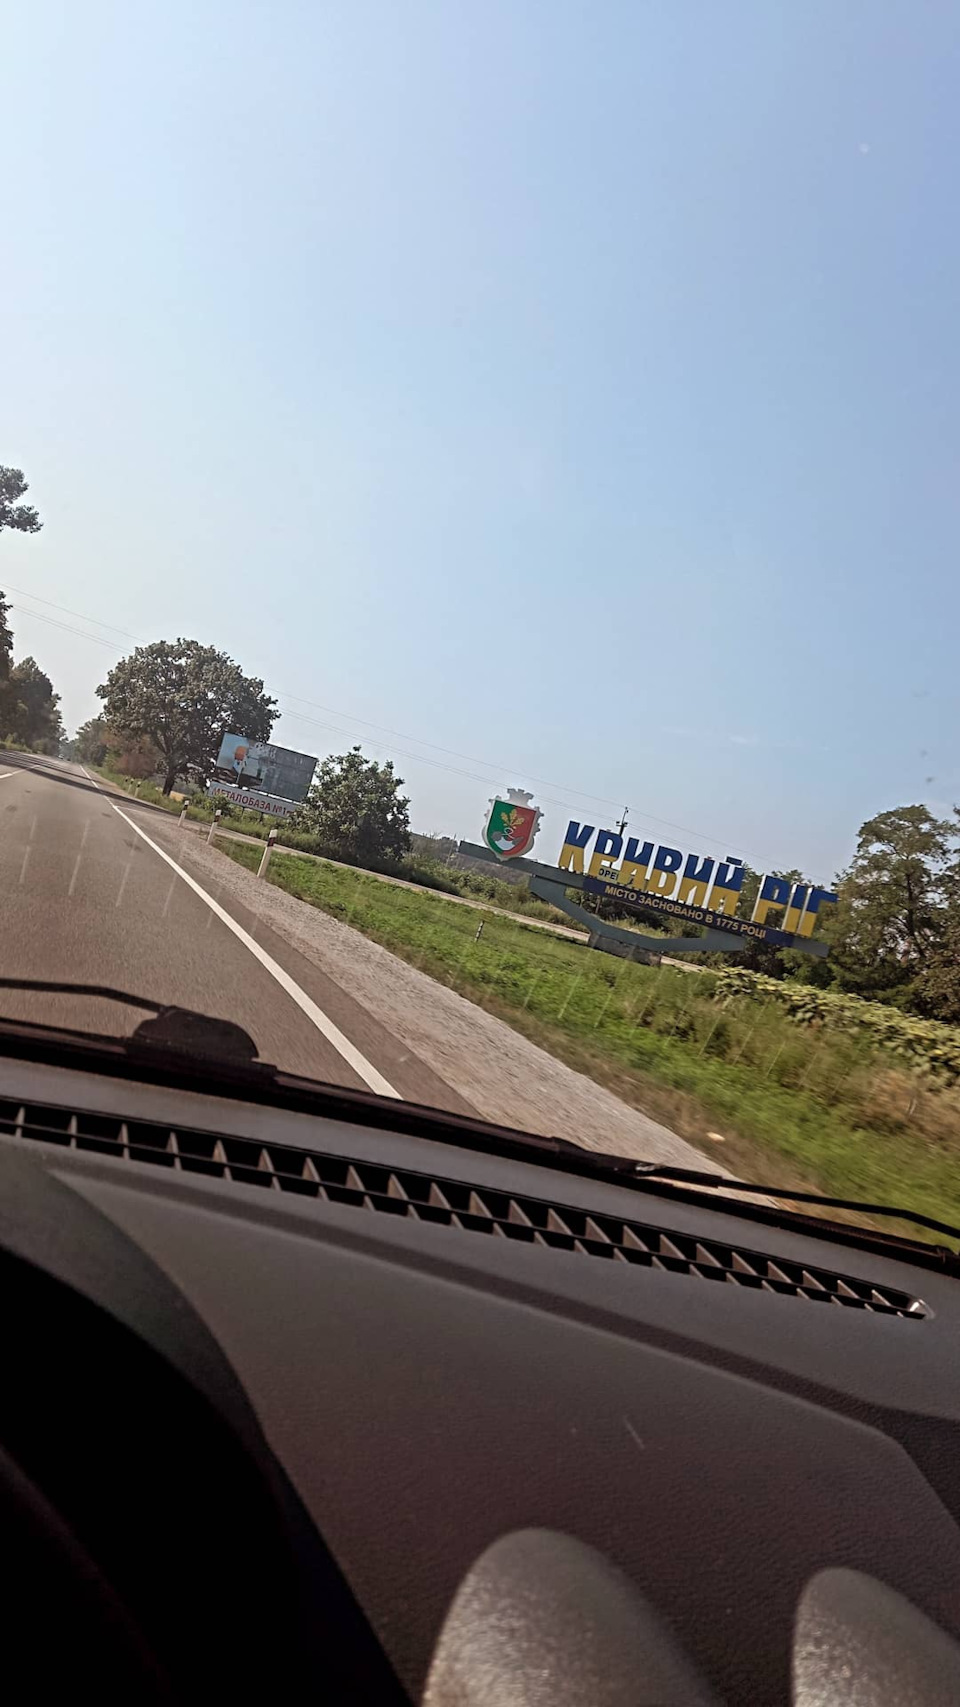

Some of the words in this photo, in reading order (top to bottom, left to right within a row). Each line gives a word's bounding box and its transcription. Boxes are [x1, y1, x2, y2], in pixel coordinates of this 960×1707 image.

[212, 787, 271, 811] МЕТАЛОБАЗА
[558, 820, 746, 916] КРИВИЙ
[752, 874, 839, 937] РІГ
[598, 868, 619, 881] ОРЕ
[605, 885, 637, 901] МІСТО
[638, 894, 704, 921] ЗАСНОВАНО
[705, 913, 713, 923] В
[716, 917, 739, 930] 1775
[740, 923, 767, 940] РОЦІ
